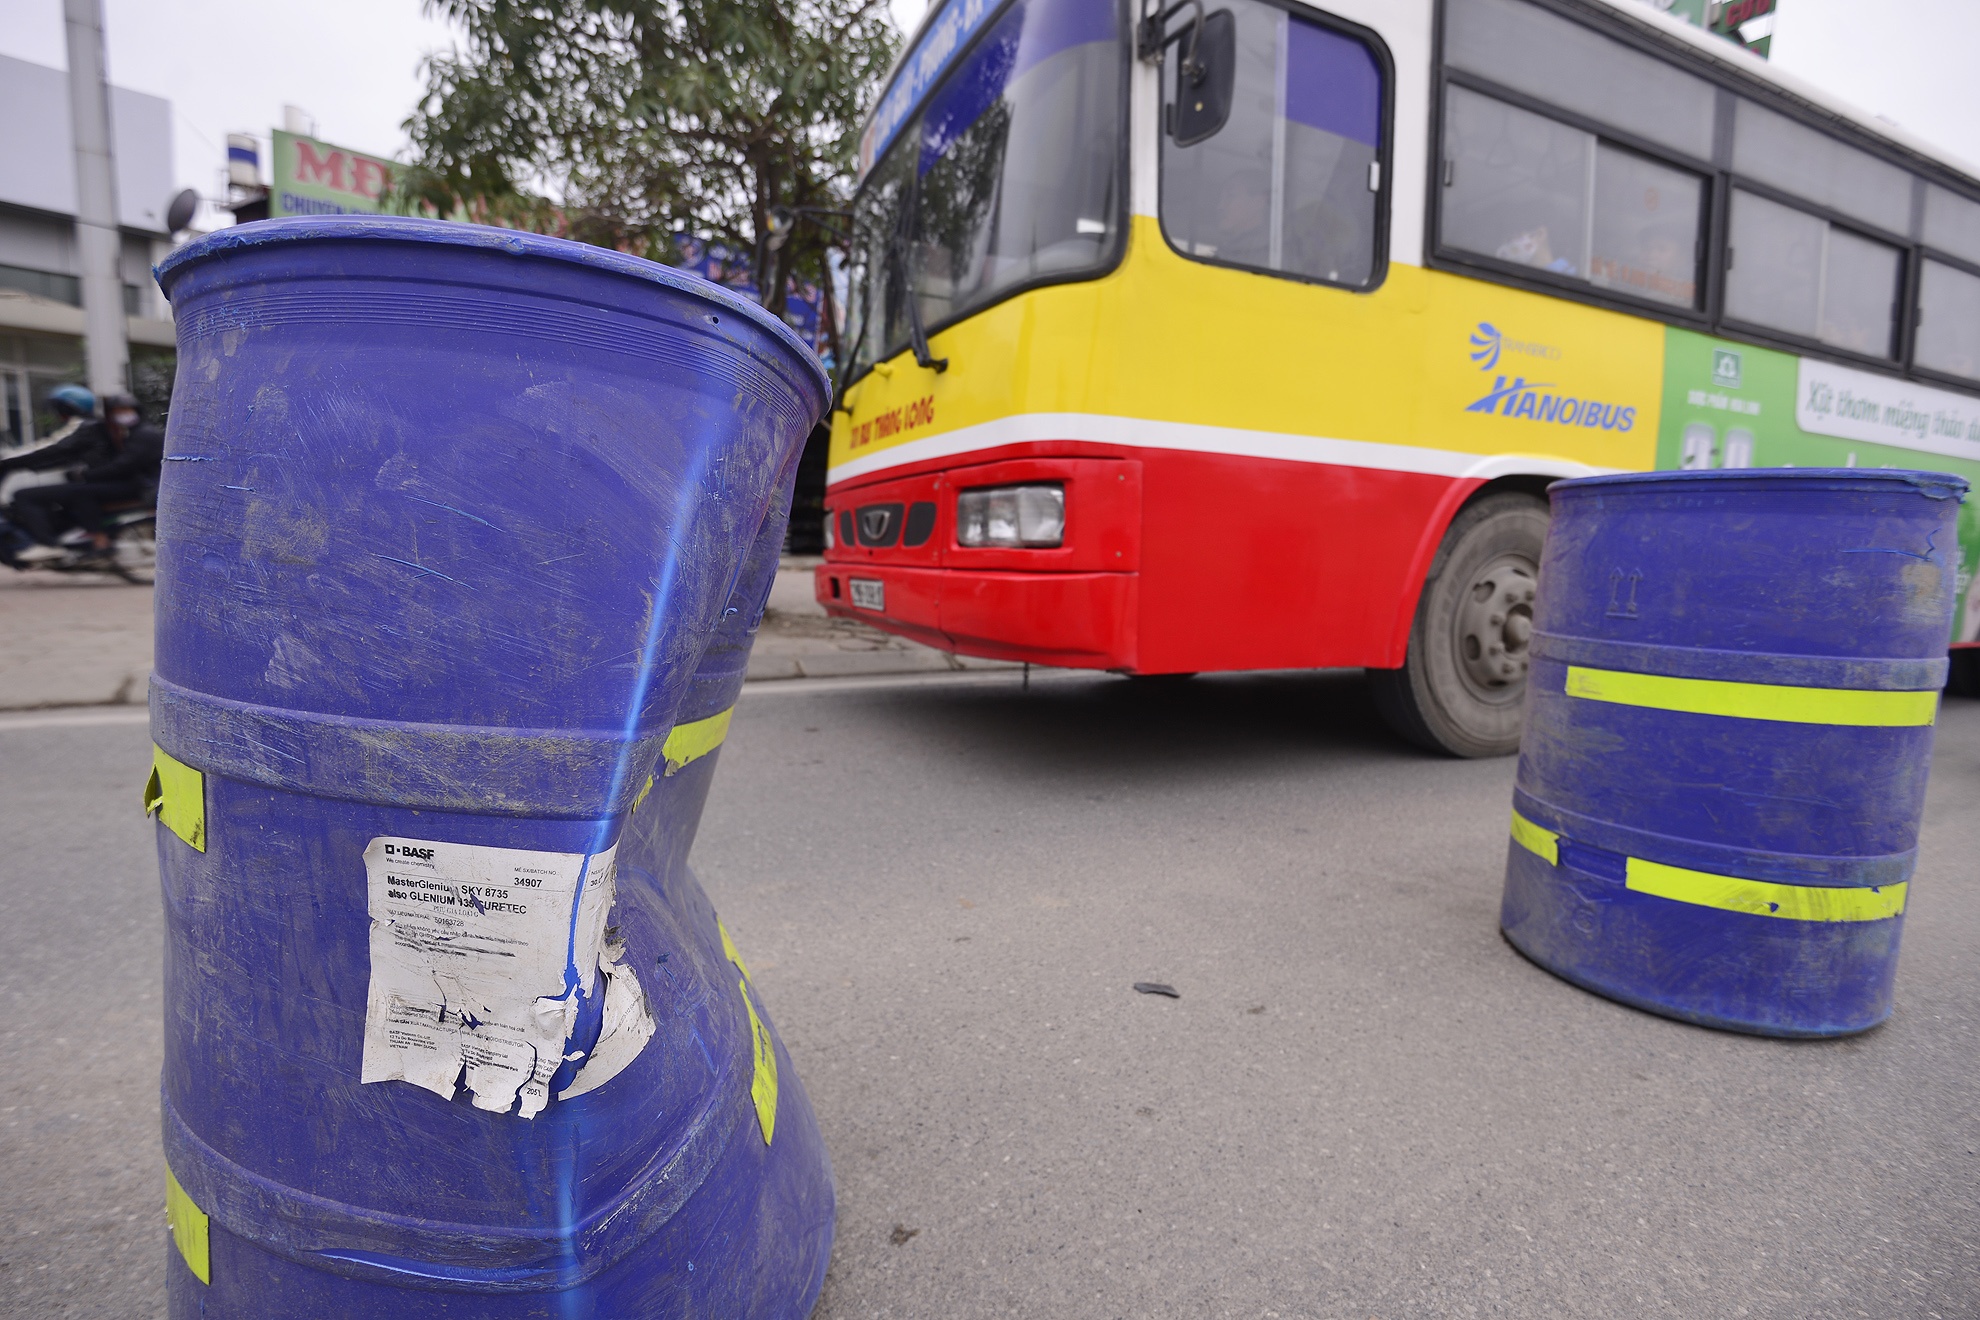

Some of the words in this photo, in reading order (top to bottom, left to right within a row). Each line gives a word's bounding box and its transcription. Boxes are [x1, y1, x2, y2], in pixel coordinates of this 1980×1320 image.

[1464, 374, 1637, 432] HANOIBUS
[402, 846, 435, 860] BASF
[514, 877, 543, 888] 34907
[388, 889, 407, 900] also
[409, 891, 455, 905] GLENIUM
[461, 885, 483, 896] SKY
[485, 888, 509, 899] 8735
